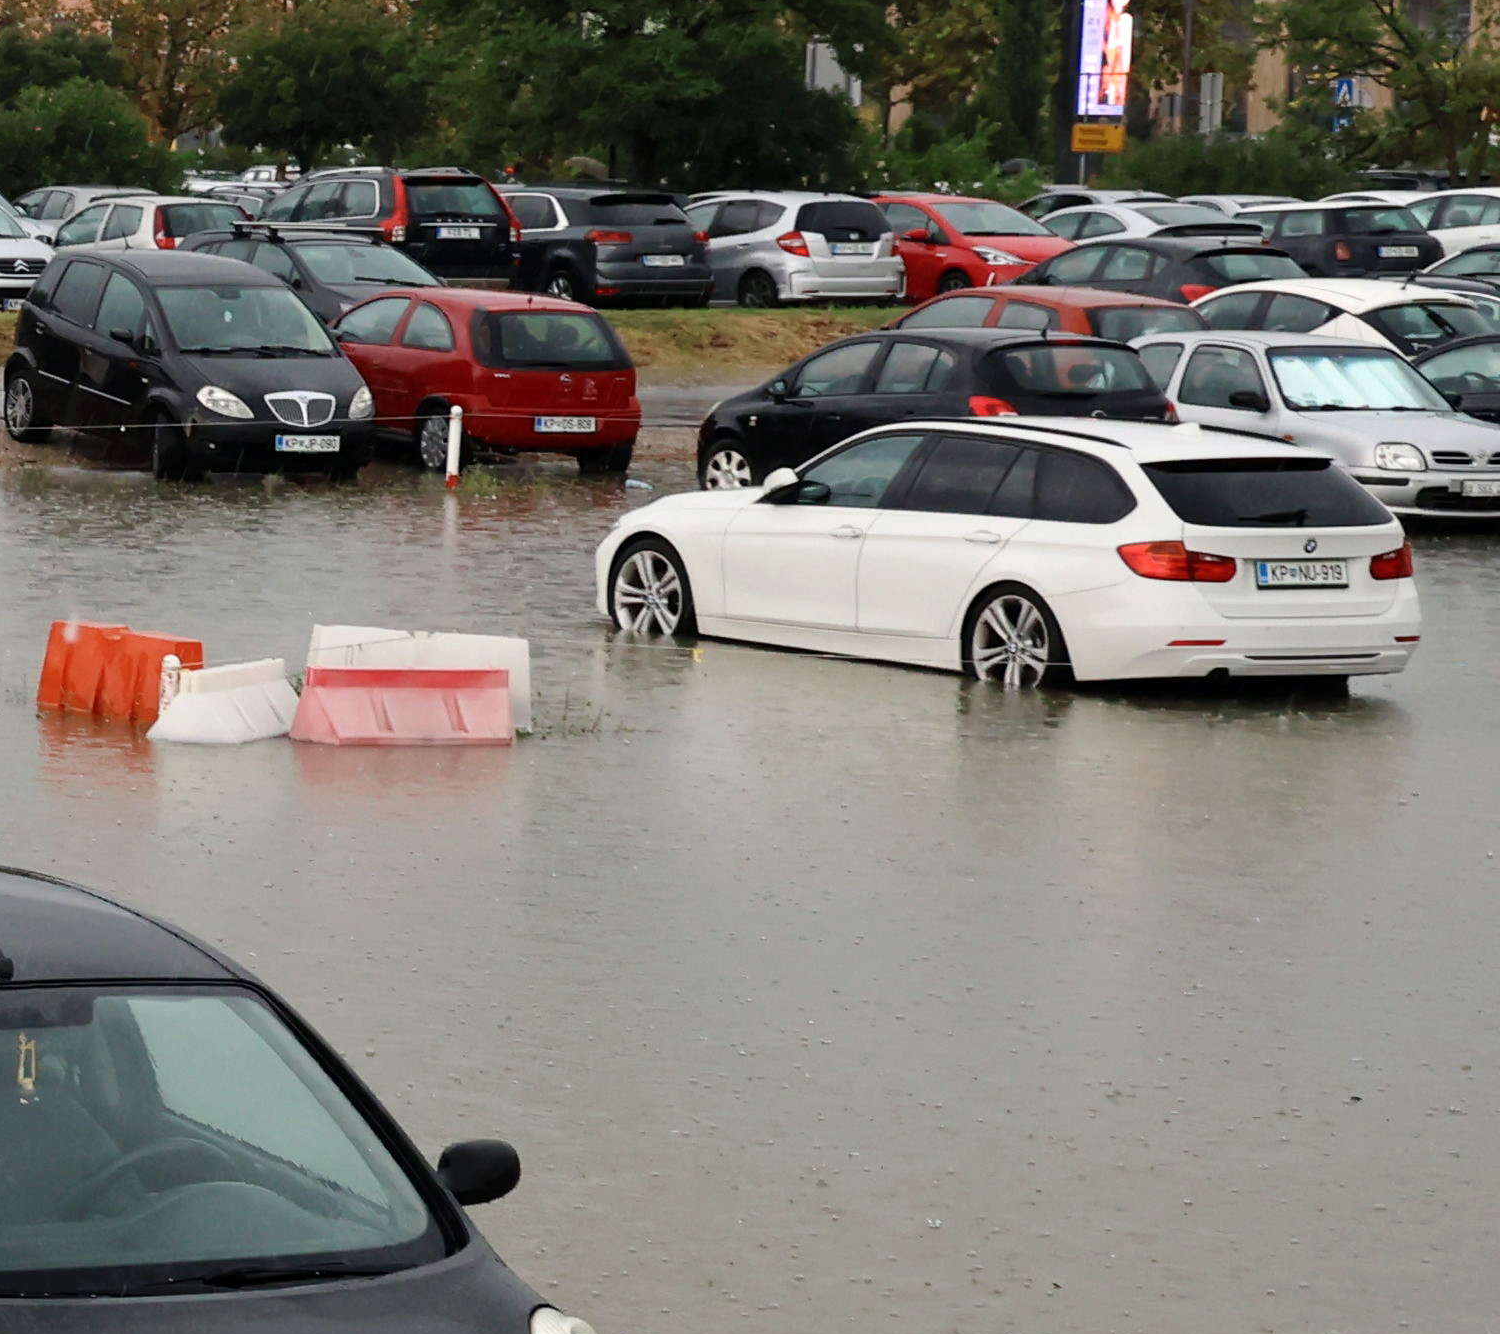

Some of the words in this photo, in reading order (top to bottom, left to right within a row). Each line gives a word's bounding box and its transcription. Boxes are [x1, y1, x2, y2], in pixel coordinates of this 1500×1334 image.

[543, 419, 554, 429] KP
[285, 438, 297, 447] KP
[1271, 565, 1288, 581] KP
[1298, 564, 1342, 581] NU-919
